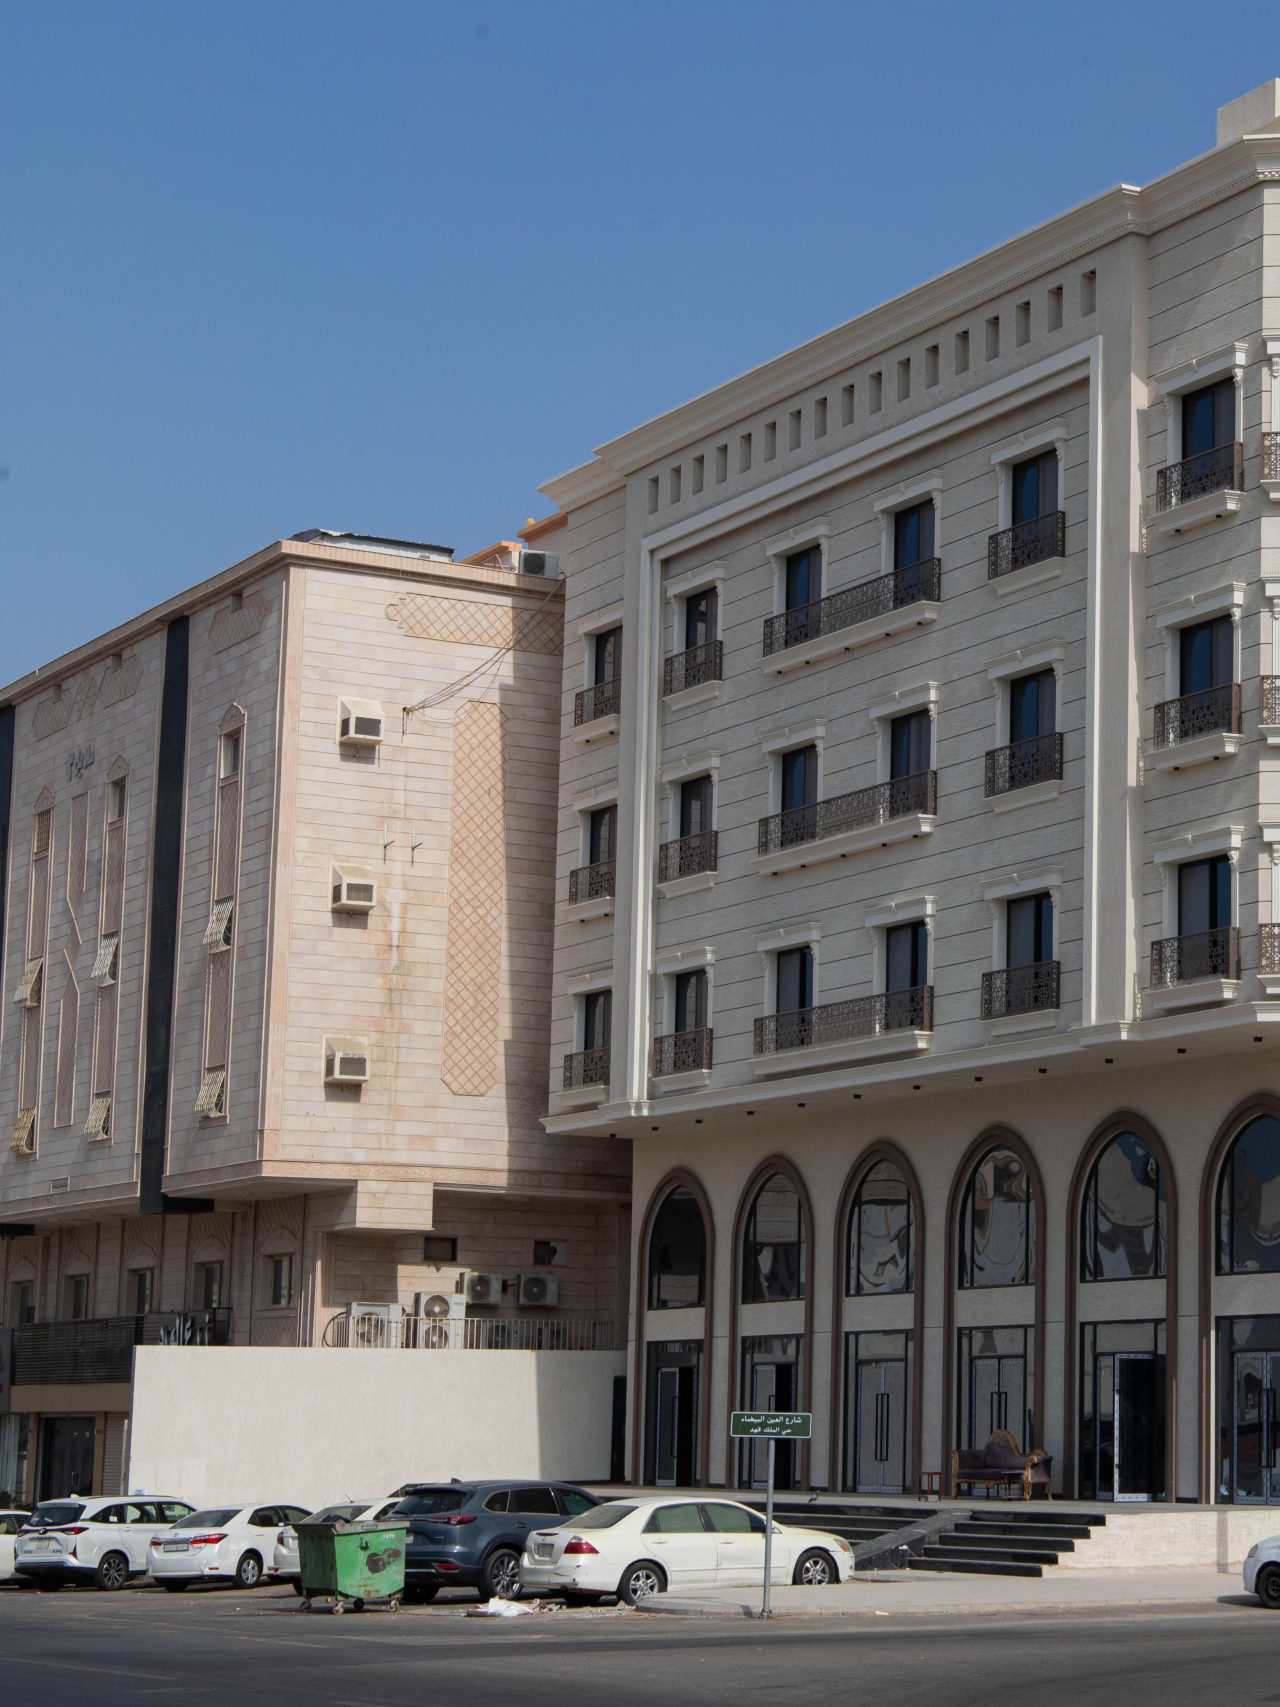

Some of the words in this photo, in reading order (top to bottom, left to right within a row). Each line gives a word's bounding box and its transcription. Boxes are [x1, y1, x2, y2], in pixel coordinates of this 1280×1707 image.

[741, 1415, 765, 1424] البيضاء
[766, 1416, 783, 1424] العين
[786, 1416, 802, 1425] شارع
[781, 1428, 792, 1436] حي
